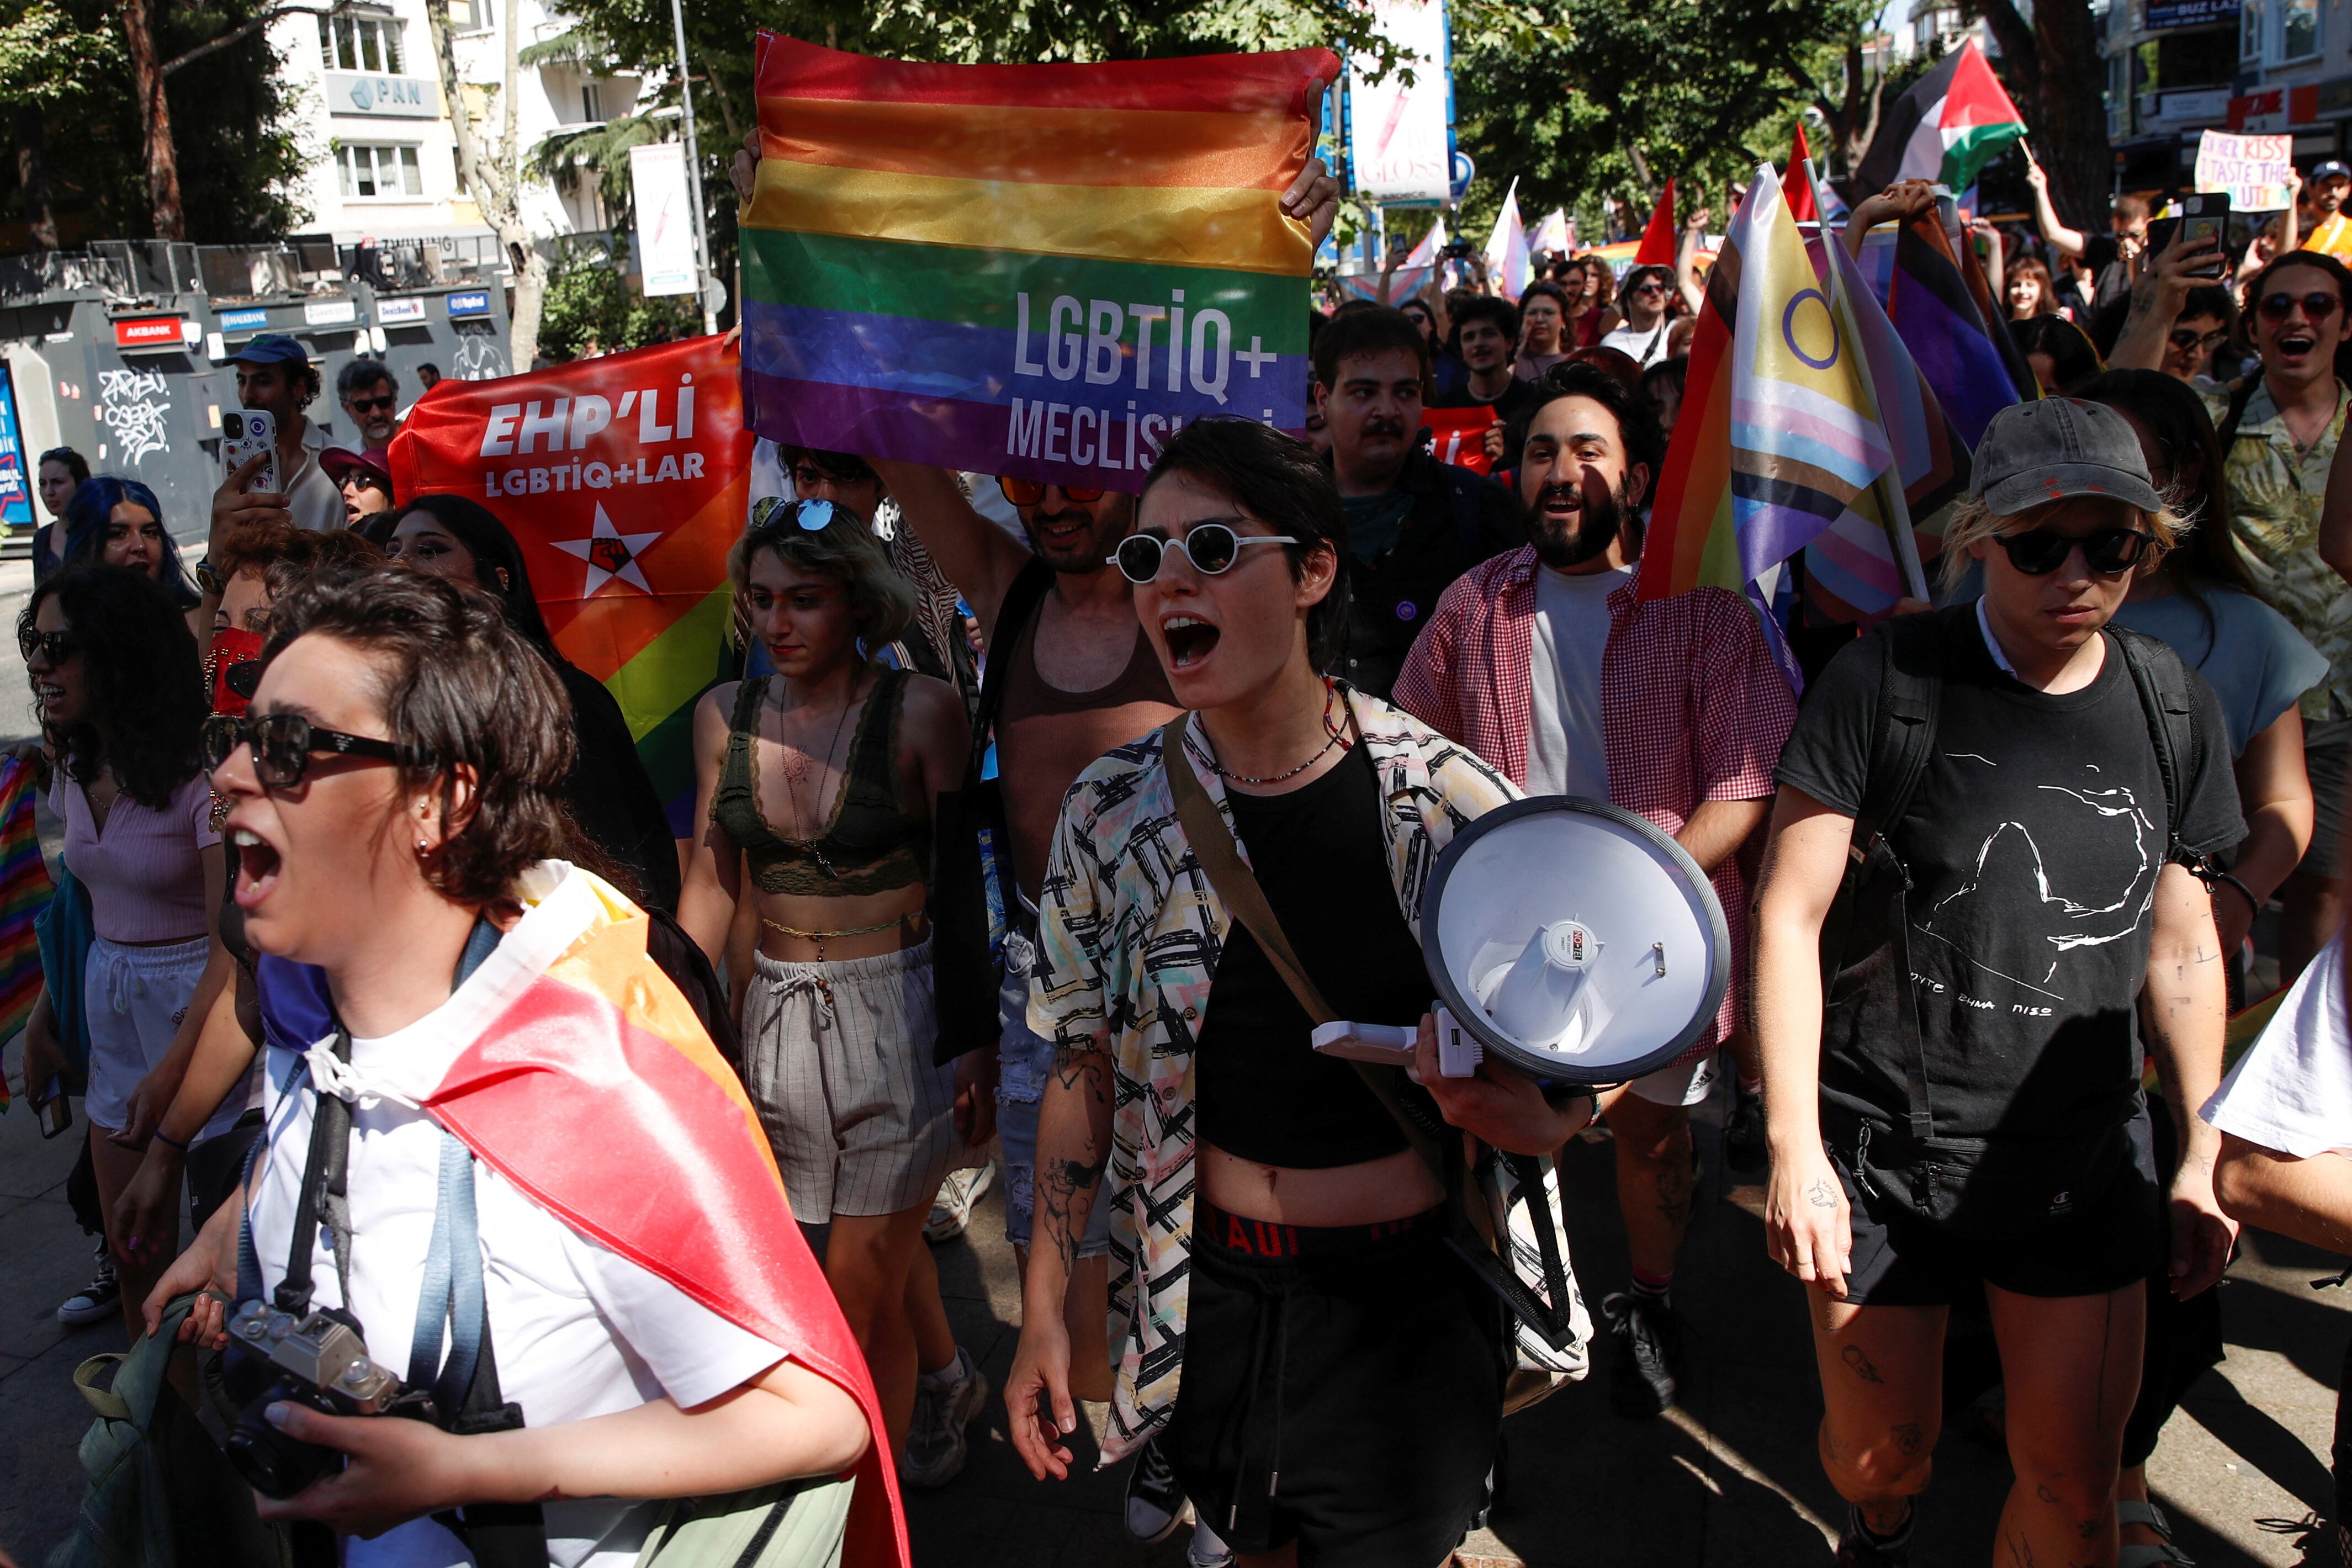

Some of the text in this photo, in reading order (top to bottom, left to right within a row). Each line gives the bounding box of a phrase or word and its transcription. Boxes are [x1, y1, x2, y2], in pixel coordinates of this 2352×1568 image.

[377, 79, 421, 104] PAN
[2218, 137, 2238, 158] HER
[2244, 136, 2284, 161] KISS
[1360, 158, 1442, 184] GLOSS
[2201, 157, 2288, 184] I TASTE THE
[126, 325, 171, 338] AKBANK
[1574, 931, 1582, 960] NO-TEL
